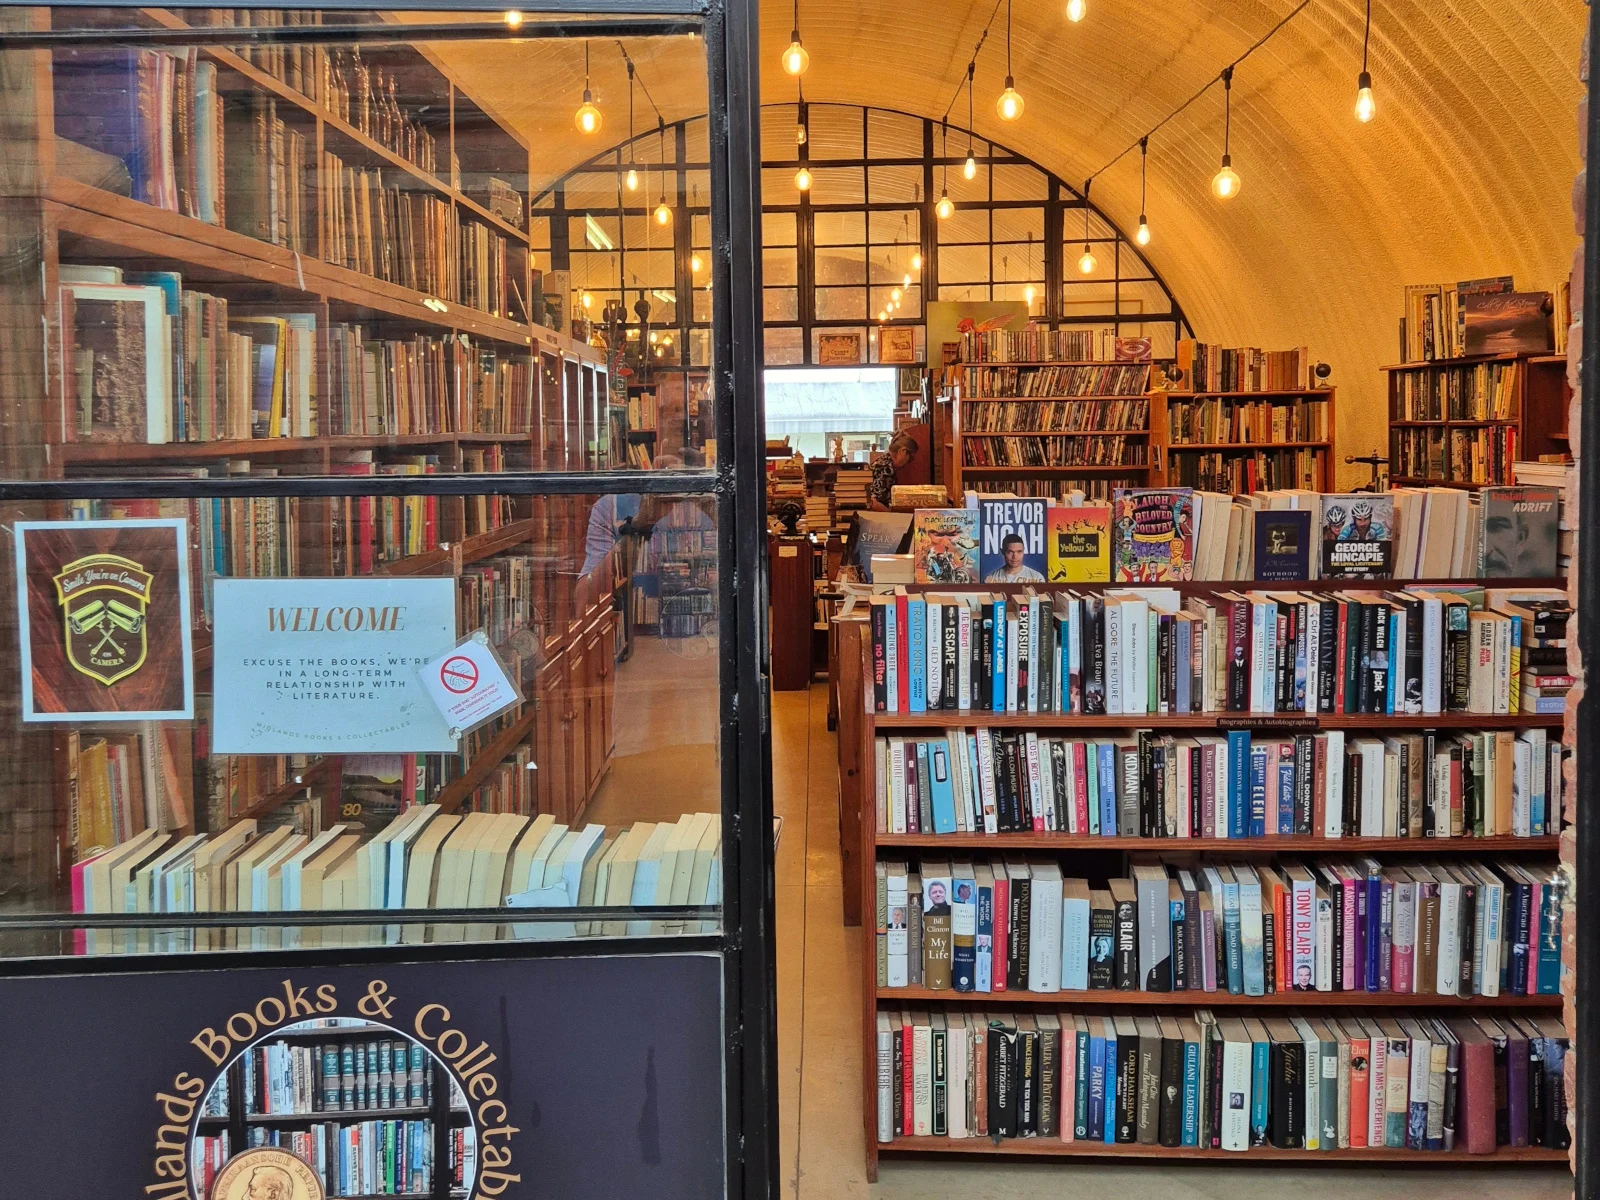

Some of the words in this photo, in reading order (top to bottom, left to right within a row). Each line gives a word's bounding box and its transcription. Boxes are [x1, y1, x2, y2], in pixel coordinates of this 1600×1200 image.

[984, 502, 1043, 524] TREVOR
[1136, 496, 1168, 508] LAUGH
[1513, 502, 1552, 512] ADRIFT
[1135, 511, 1172, 522] BELOVED
[1135, 521, 1173, 532] COUNTRY
[1060, 543, 1084, 553] Yellow
[1085, 543, 1097, 552] Six
[1073, 535, 1085, 544] the
[1335, 543, 1380, 552] GEORGE
[1331, 553, 1384, 562] HINCAPIE
[63, 574, 84, 592] Smile
[119, 572, 145, 591] Camera
[268, 607, 407, 632] WELCOME
[913, 605, 922, 646] TRAITOR
[1110, 610, 1117, 619] AL
[1377, 607, 1386, 624] JACK
[945, 628, 955, 664] ESCAPE
[997, 639, 1003, 648] AT
[1019, 611, 1028, 661] EXPOSURE
[1321, 609, 1333, 667] BORAINE
[1377, 626, 1385, 648] WELCH
[91, 657, 124, 666] CAMERA
[876, 644, 882, 657] no
[914, 649, 922, 674] KING
[1095, 644, 1103, 658] Eva
[1456, 640, 1467, 676] TESTAMENT
[332, 658, 381, 666] BOOKS,
[876, 659, 885, 685] filter
[1095, 661, 1103, 685] Braun
[1373, 670, 1385, 692] jack
[1456, 676, 1467, 684] OF
[1456, 686, 1467, 703] HOPE
[347, 721, 411, 739] COLLECTABLES
[1029, 740, 1037, 761] LOST
[1031, 763, 1039, 781] BOYS
[1125, 753, 1138, 794] KIDMAN
[1281, 769, 1292, 784] Fidel
[1253, 786, 1264, 820] ELENI
[1283, 785, 1292, 802] Castro
[343, 803, 361, 816] 80
[1020, 883, 1029, 922] DONALD
[1297, 888, 1310, 918] TONY
[1345, 886, 1354, 929] KARDASHIAN
[931, 938, 947, 949] My
[1296, 921, 1310, 955] BLAIR
[1345, 930, 1354, 960] DYNASTY
[1424, 917, 1433, 956] Greenspan
[928, 950, 949, 959] Life
[1020, 924, 1028, 976] RUMSFELD
[1187, 1045, 1196, 1080] GIULIANI
[1281, 1044, 1297, 1084] Jackie
[1375, 1040, 1384, 1069] MARTIN
[878, 1048, 890, 1090] THALBERG
[904, 1053, 912, 1090] TRUMP
[190, 979, 338, 1067] Books
[357, 979, 398, 1019] &
[414, 1003, 522, 1200] Collectab
[1092, 1066, 1102, 1099] PARKY
[1375, 1072, 1384, 1090] AMIS
[1127, 1076, 1135, 1123] HAILSHAM
[1186, 1084, 1195, 1132] LEADERSHIP
[1373, 1098, 1383, 1145] EXPERIENCE
